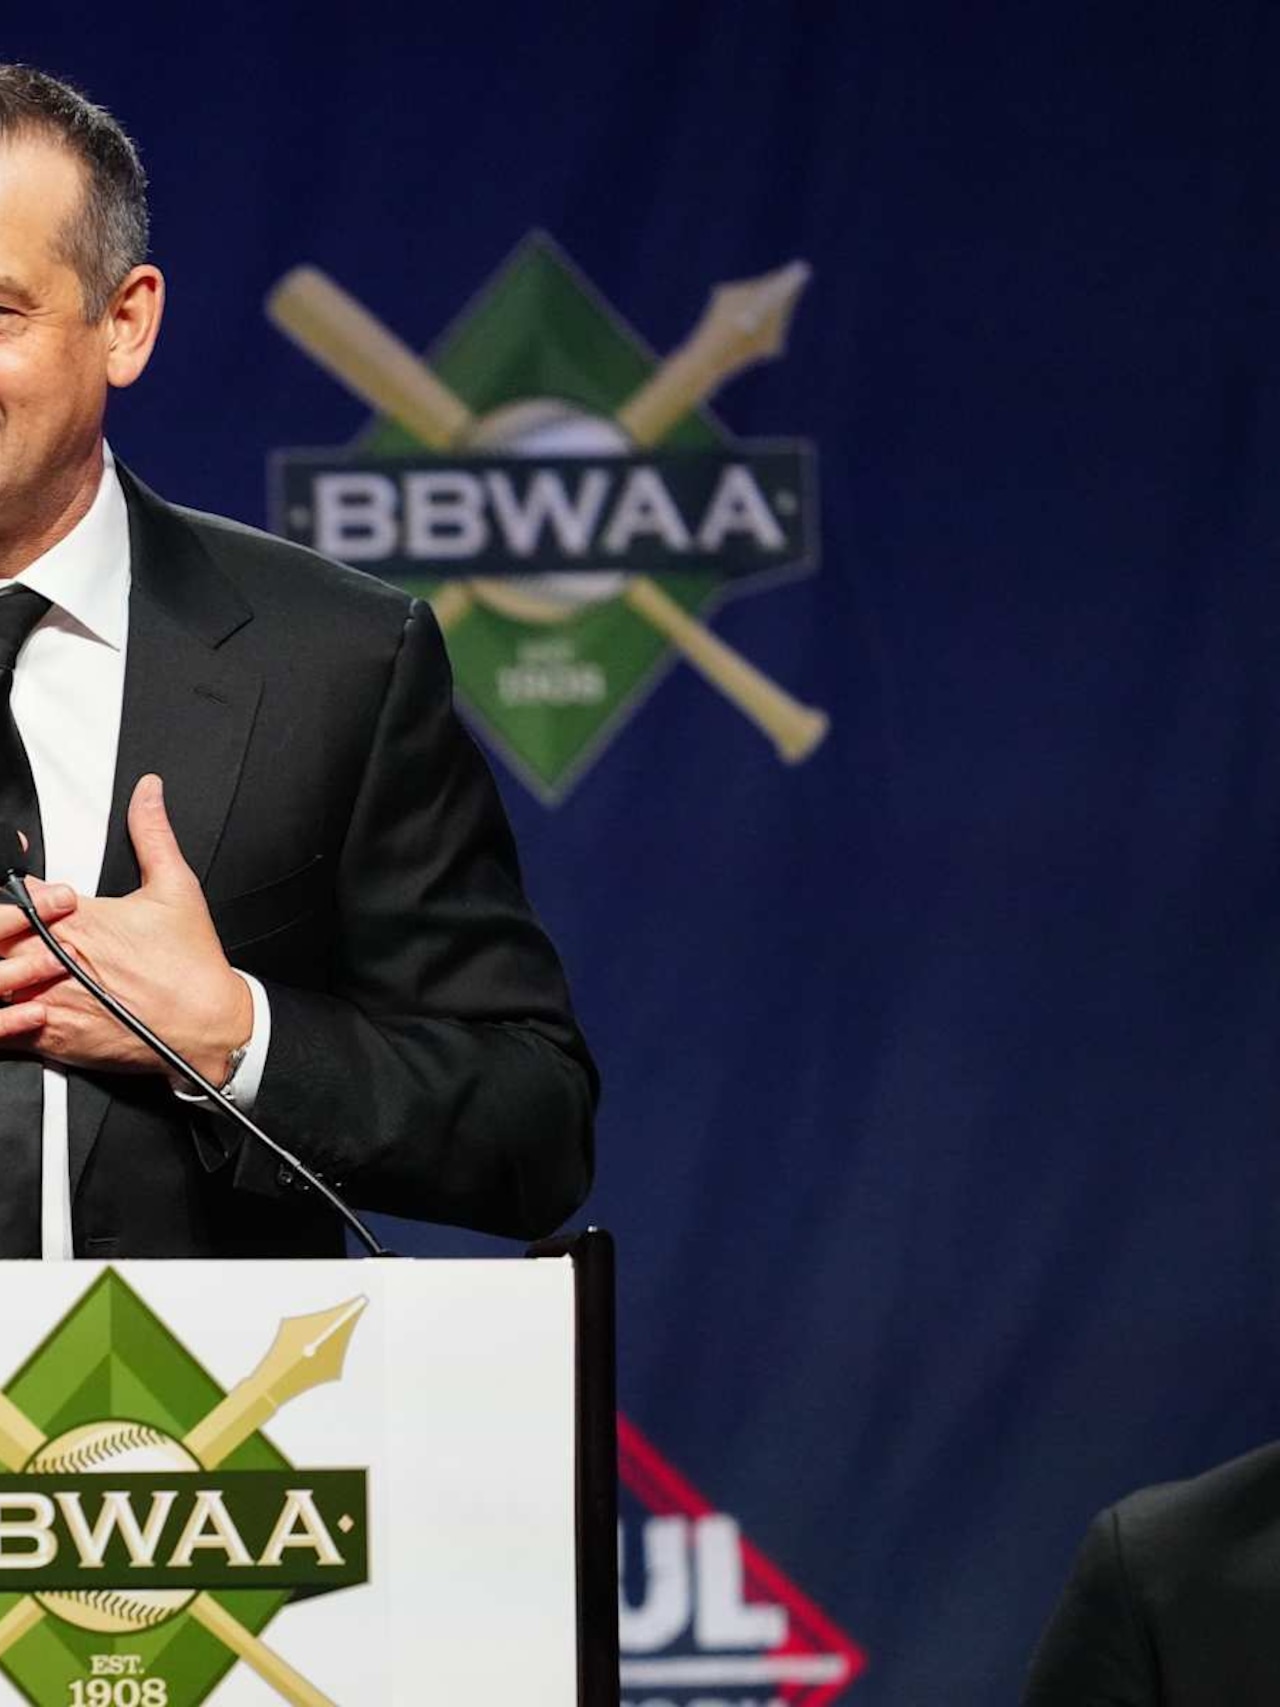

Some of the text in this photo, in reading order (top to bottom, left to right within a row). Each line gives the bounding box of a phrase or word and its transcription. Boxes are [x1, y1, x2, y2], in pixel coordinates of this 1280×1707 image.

[313, 466, 784, 559] BBWAA
[90, 1653, 145, 1675] EST.
[67, 1677, 169, 1707] 1908
